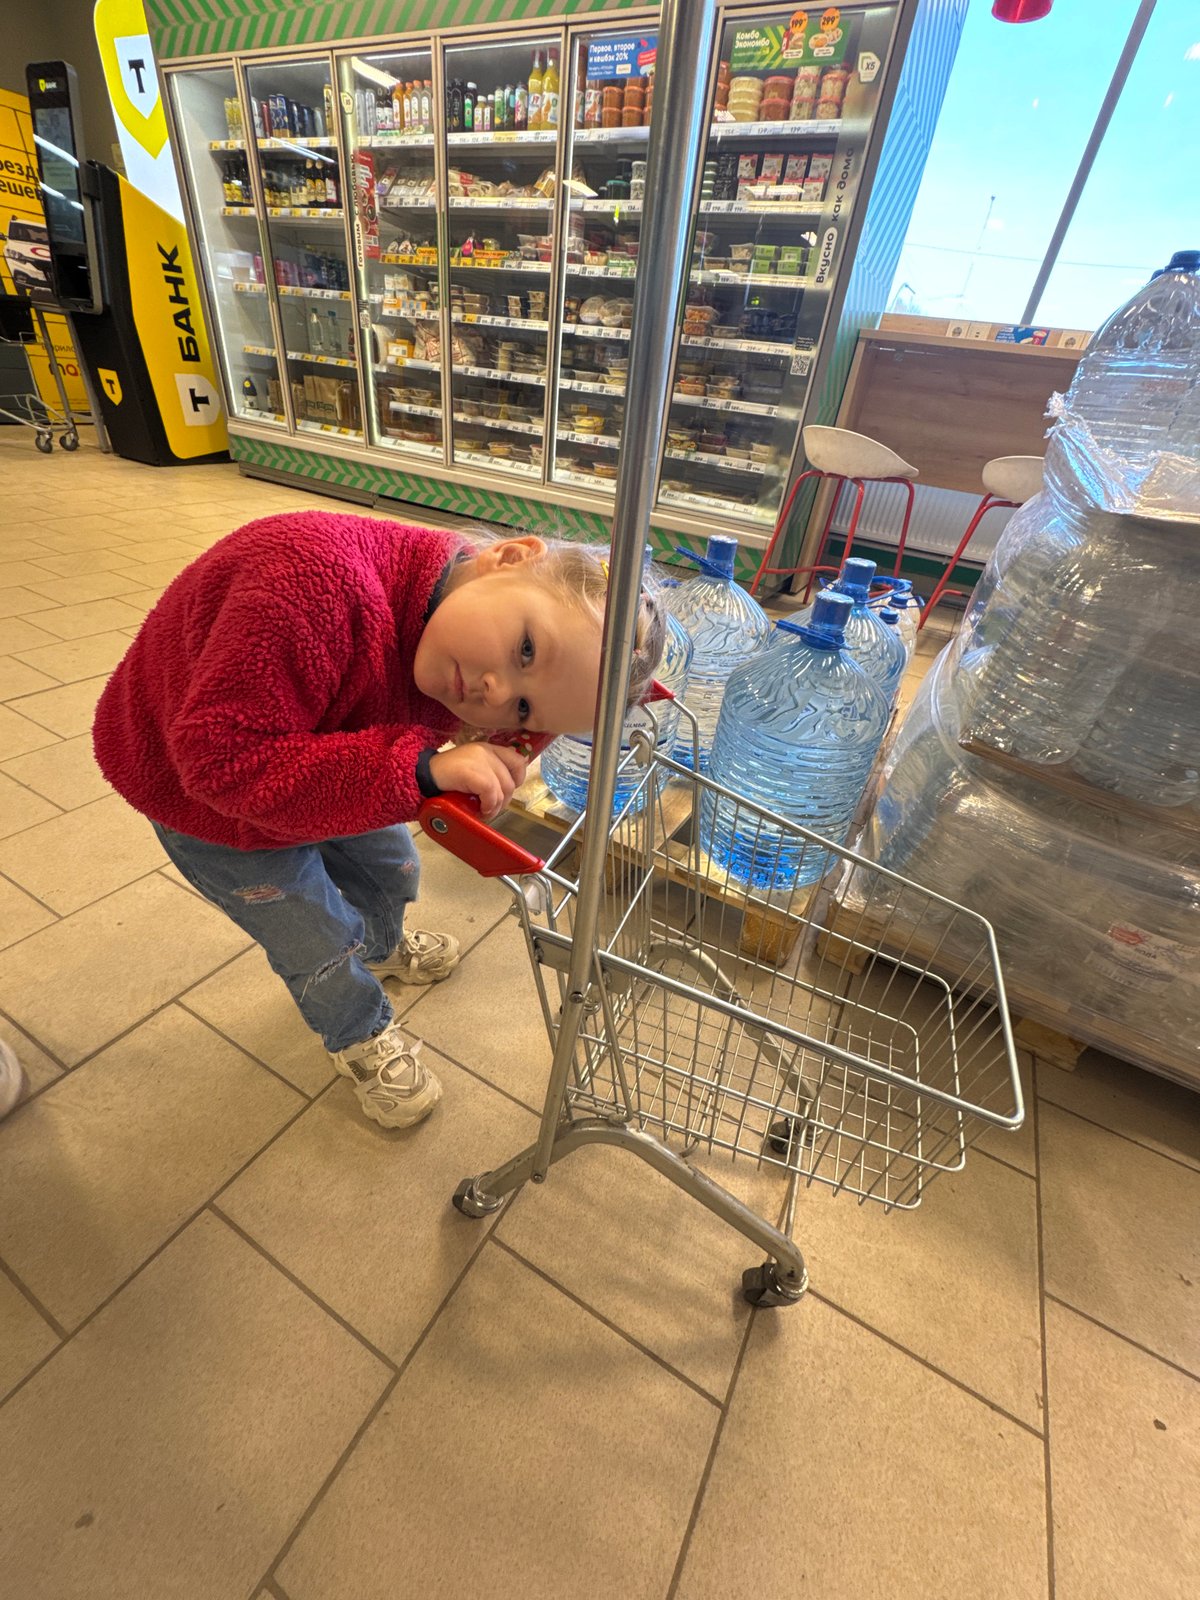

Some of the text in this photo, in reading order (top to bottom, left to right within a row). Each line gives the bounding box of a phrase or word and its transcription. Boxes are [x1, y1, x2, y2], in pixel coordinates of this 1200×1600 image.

[734, 38, 771, 49] Экономбо
[735, 29, 760, 40] Комбо
[815, 147, 855, 284] Вкусно как дома
[156, 241, 202, 362] БАНК
